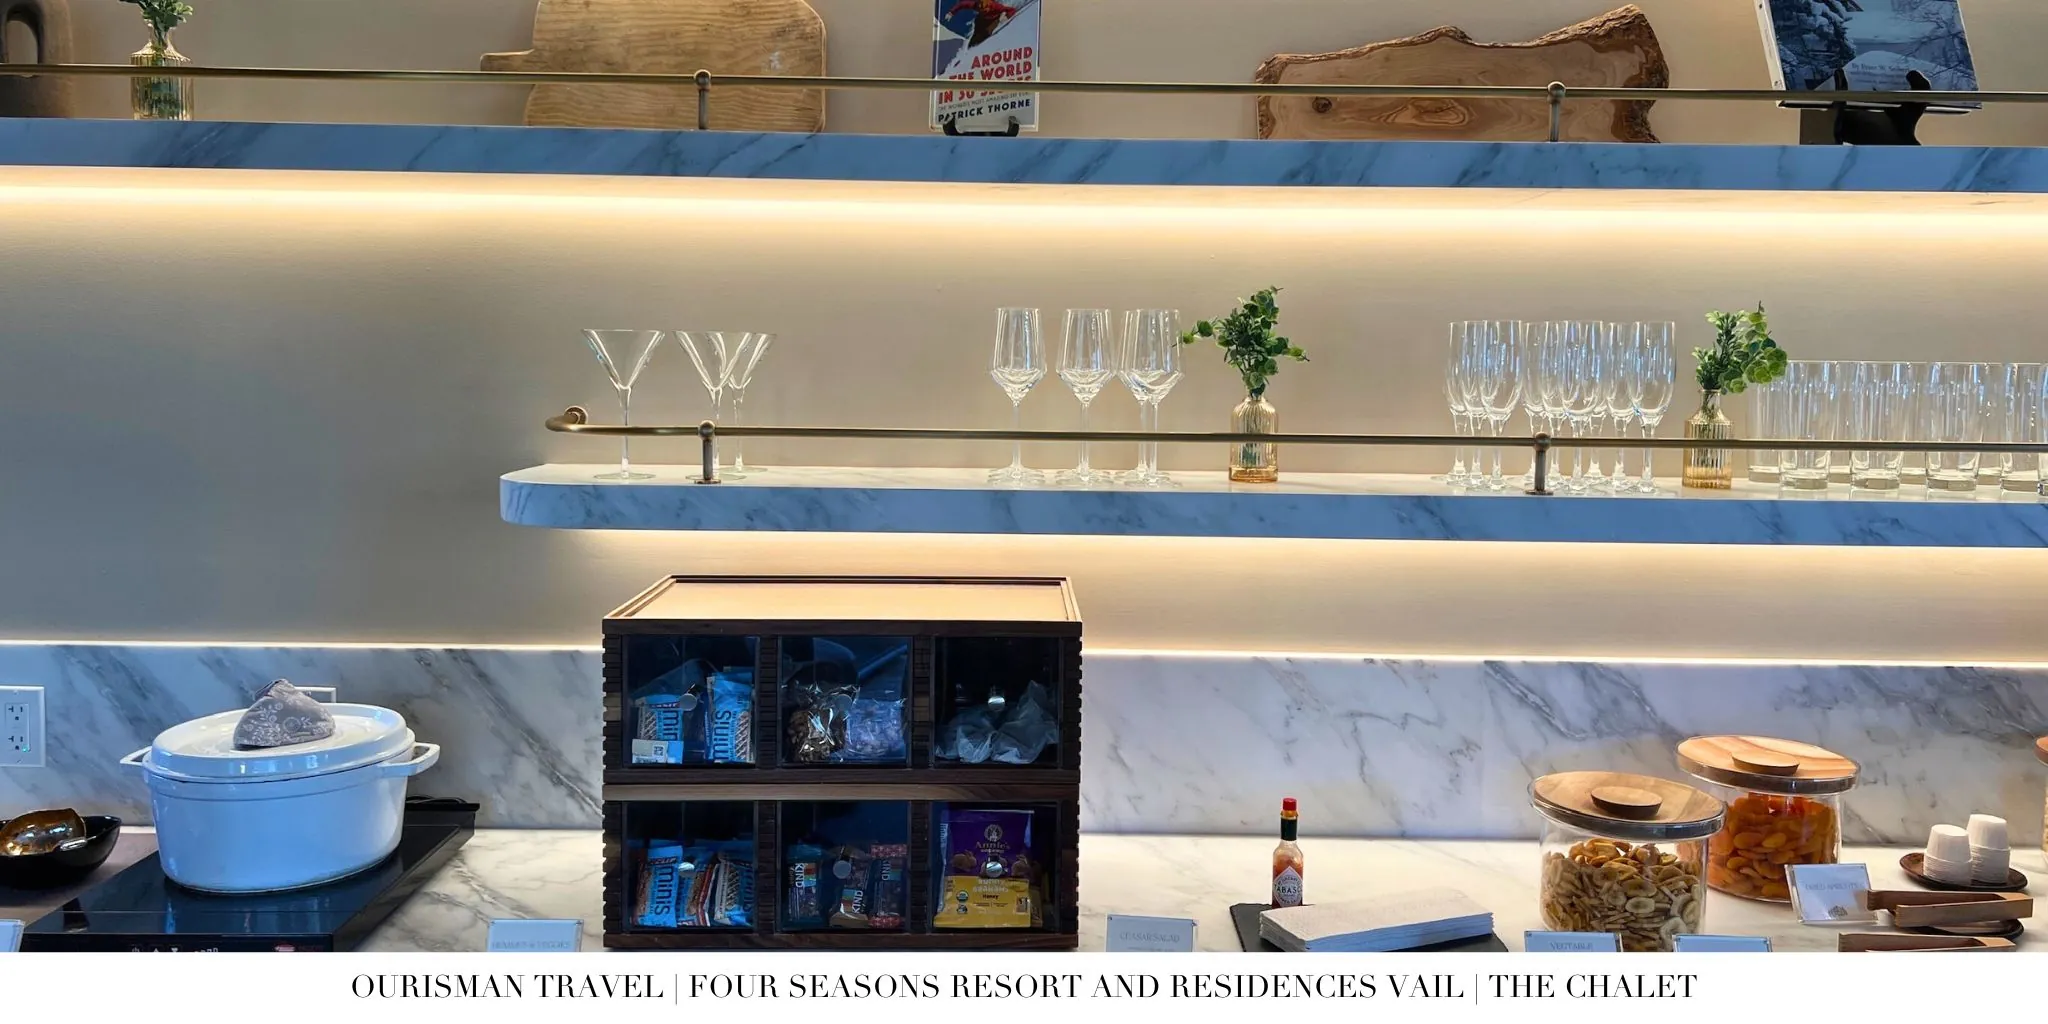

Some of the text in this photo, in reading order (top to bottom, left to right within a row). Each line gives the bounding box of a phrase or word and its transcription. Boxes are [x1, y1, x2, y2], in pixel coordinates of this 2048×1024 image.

[971, 46, 1033, 69] AROUND
[981, 61, 1032, 81] WORLD
[938, 90, 954, 104] IN
[938, 99, 1030, 122] PATRICK THORNE
[713, 710, 732, 759] minis
[794, 863, 805, 888] KIND
[655, 864, 675, 915] minis
[1274, 883, 1302, 893] TABAS
[852, 890, 863, 914] KIND
